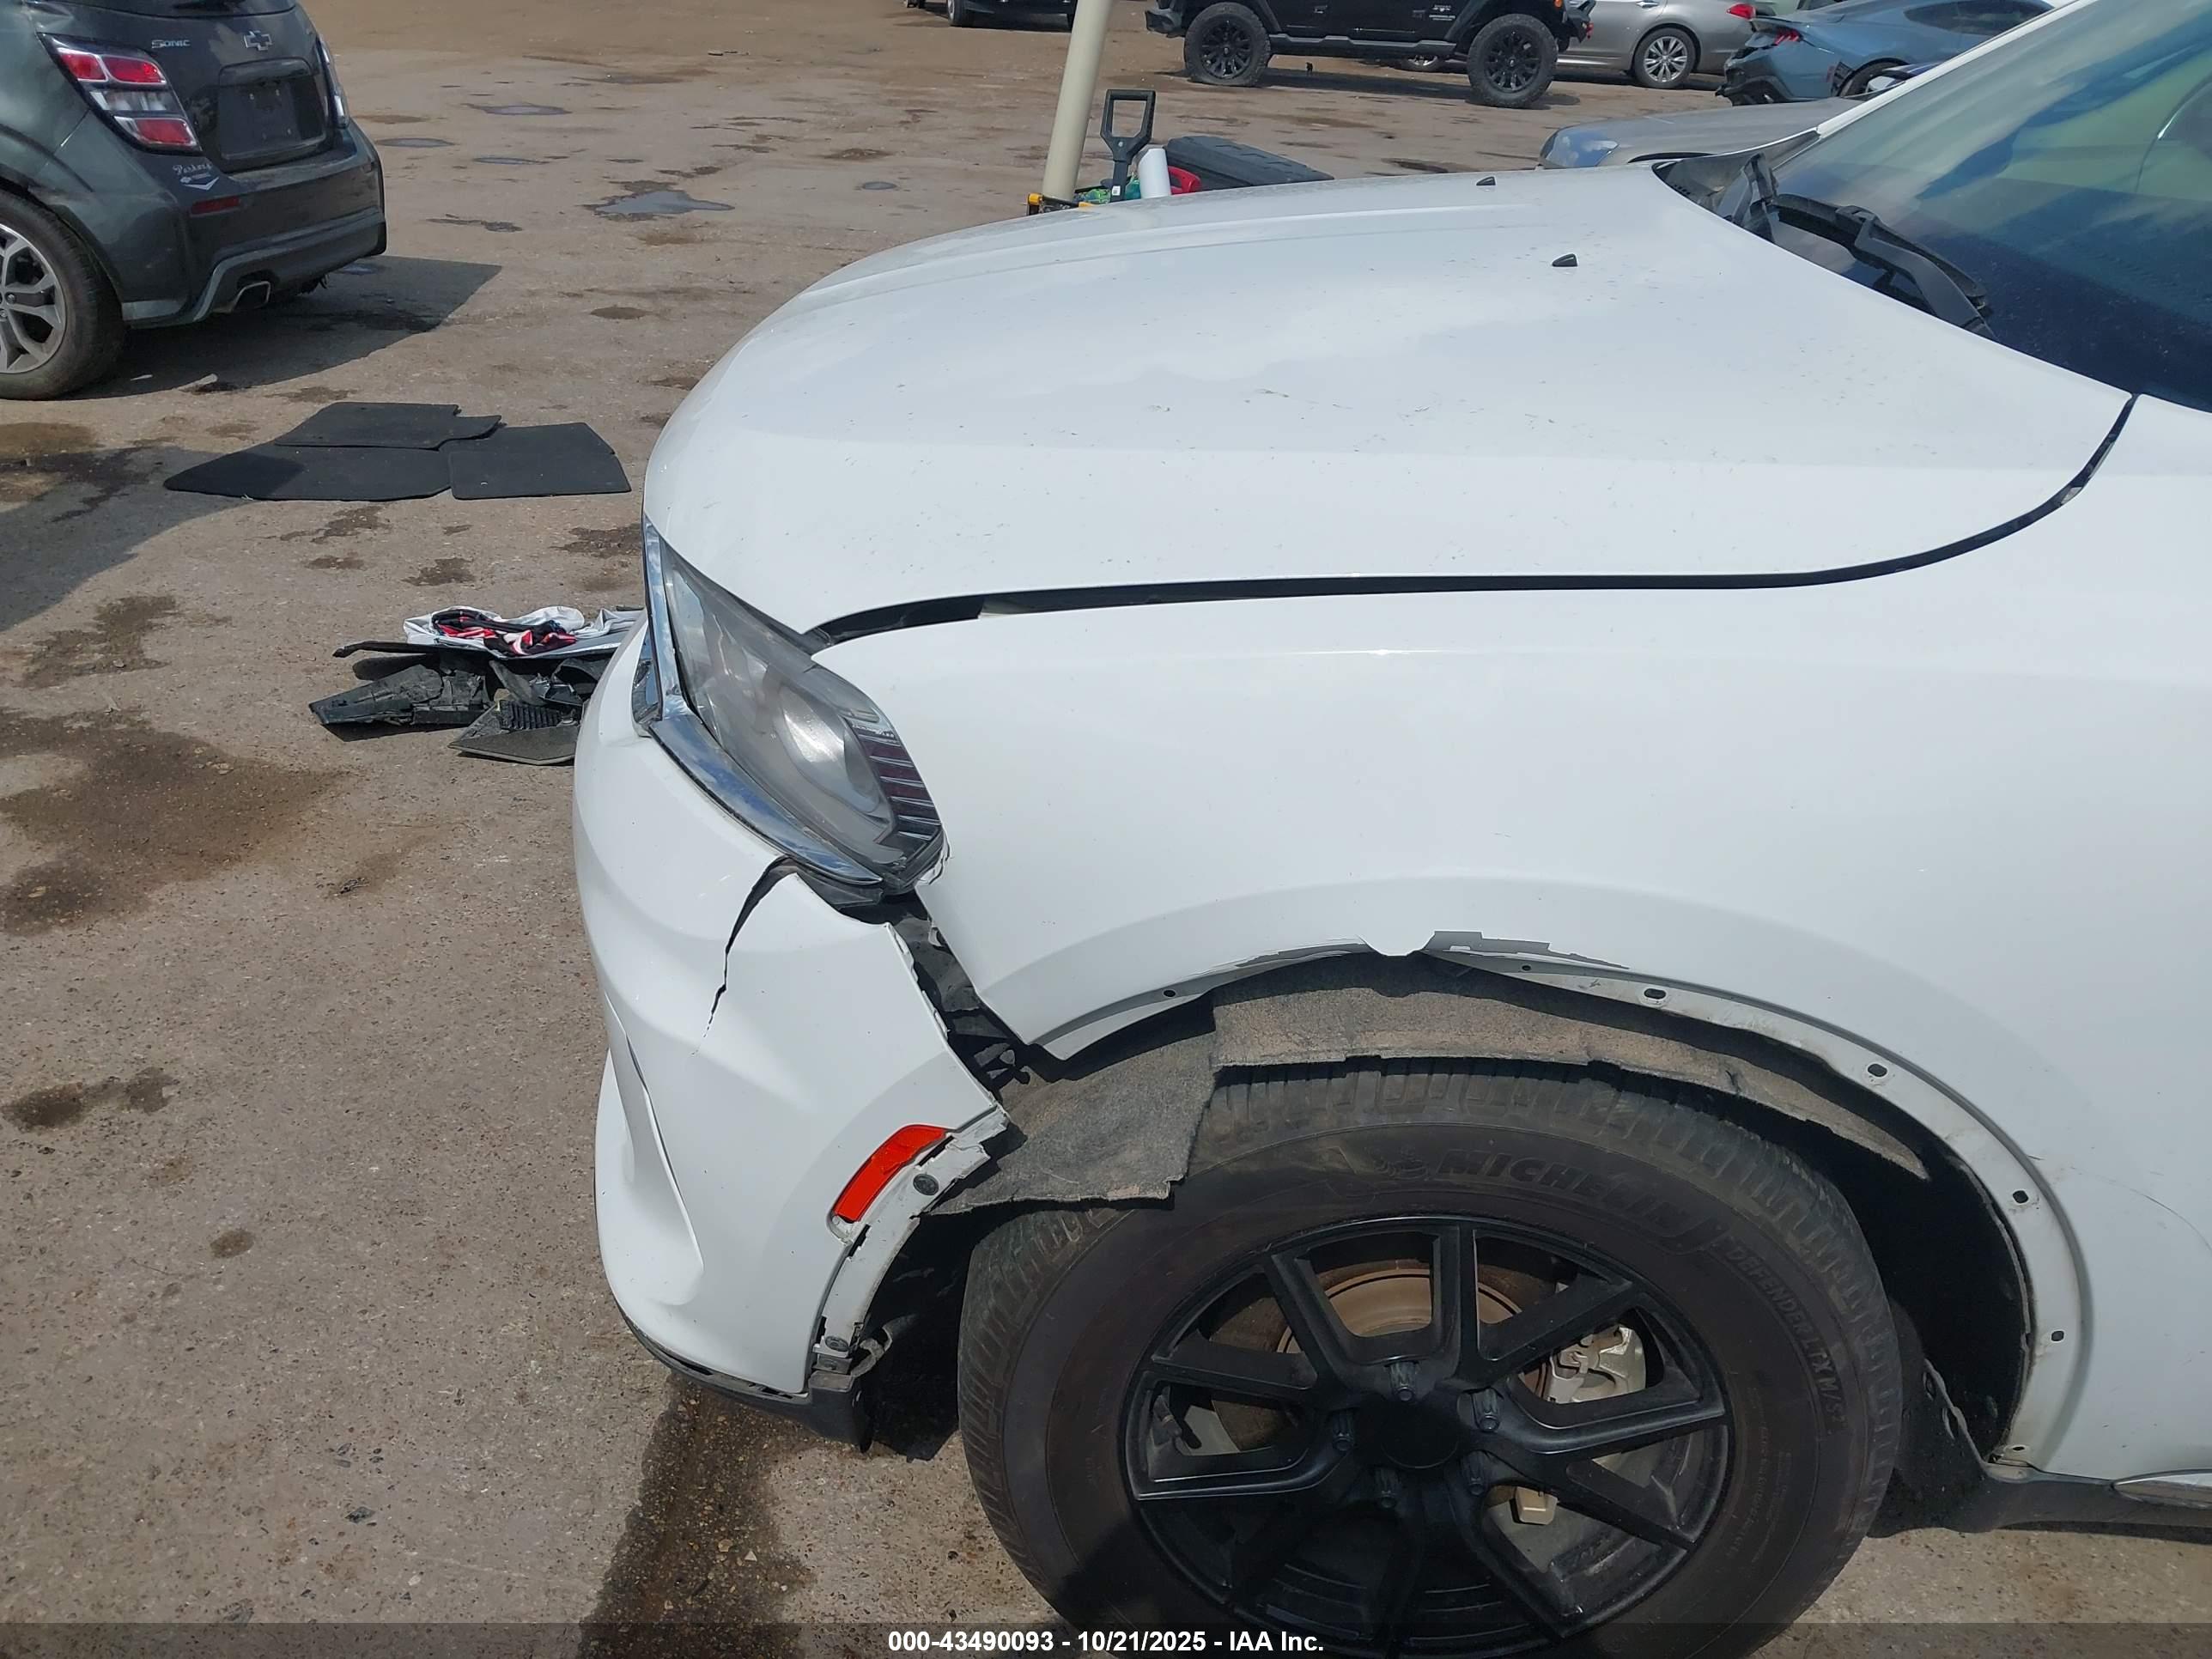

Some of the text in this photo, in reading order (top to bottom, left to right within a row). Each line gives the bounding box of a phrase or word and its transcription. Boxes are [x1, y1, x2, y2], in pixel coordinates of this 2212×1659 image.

[151, 39, 191, 49] SONIC
[1436, 1148, 1692, 1231] MICHELIN
[1725, 1245, 1814, 1335] DEFENDER
